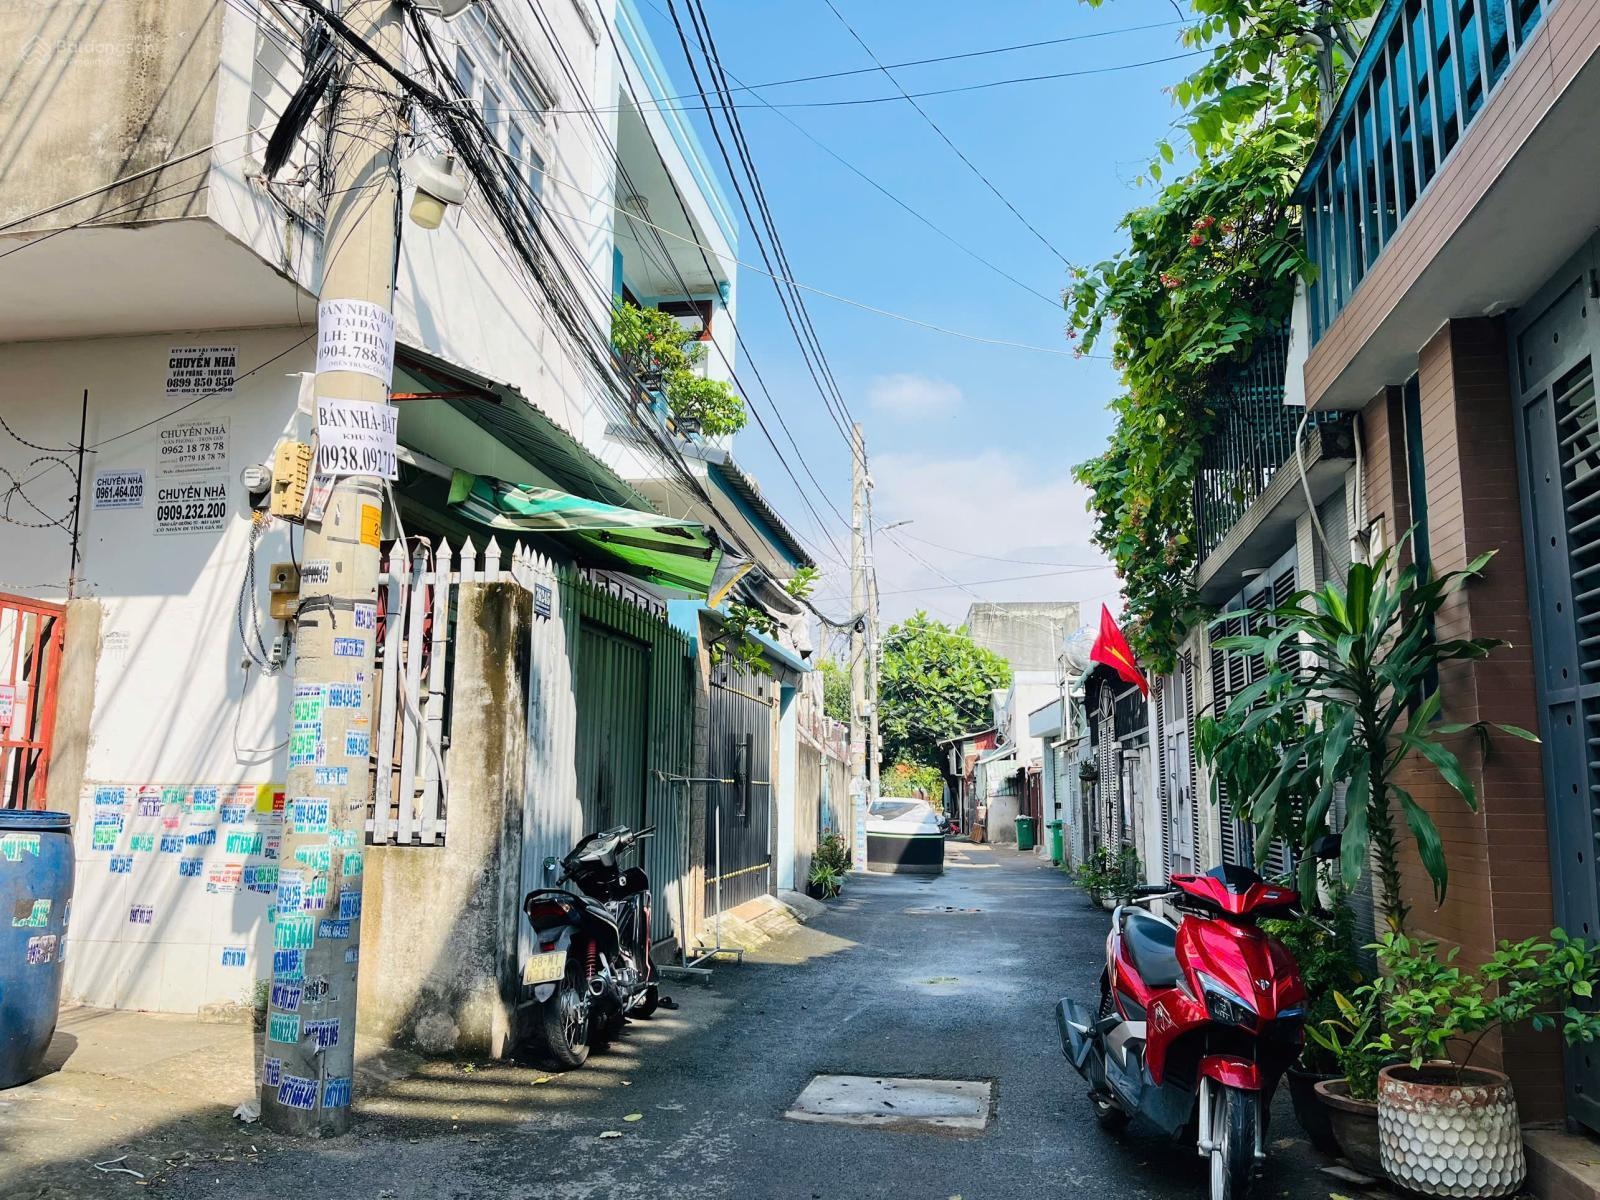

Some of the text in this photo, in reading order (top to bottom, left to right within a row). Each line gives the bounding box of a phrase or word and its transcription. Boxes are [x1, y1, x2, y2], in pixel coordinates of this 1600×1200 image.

[169, 353, 236, 368] CHUYỂN NHÀ
[166, 377, 234, 387] 0899 850 850
[319, 402, 347, 427] BÁN
[161, 426, 202, 438] CHUYỂN
[205, 424, 226, 435] NHÀ
[162, 441, 224, 454] 0962 18 78 78
[97, 475, 143, 486] CHUYỂN NHÀ
[96, 485, 143, 499] 0961.464.030
[158, 485, 201, 500] CHUYỂN
[204, 483, 226, 497] NHÀ
[157, 502, 226, 521] 0909.232.200
